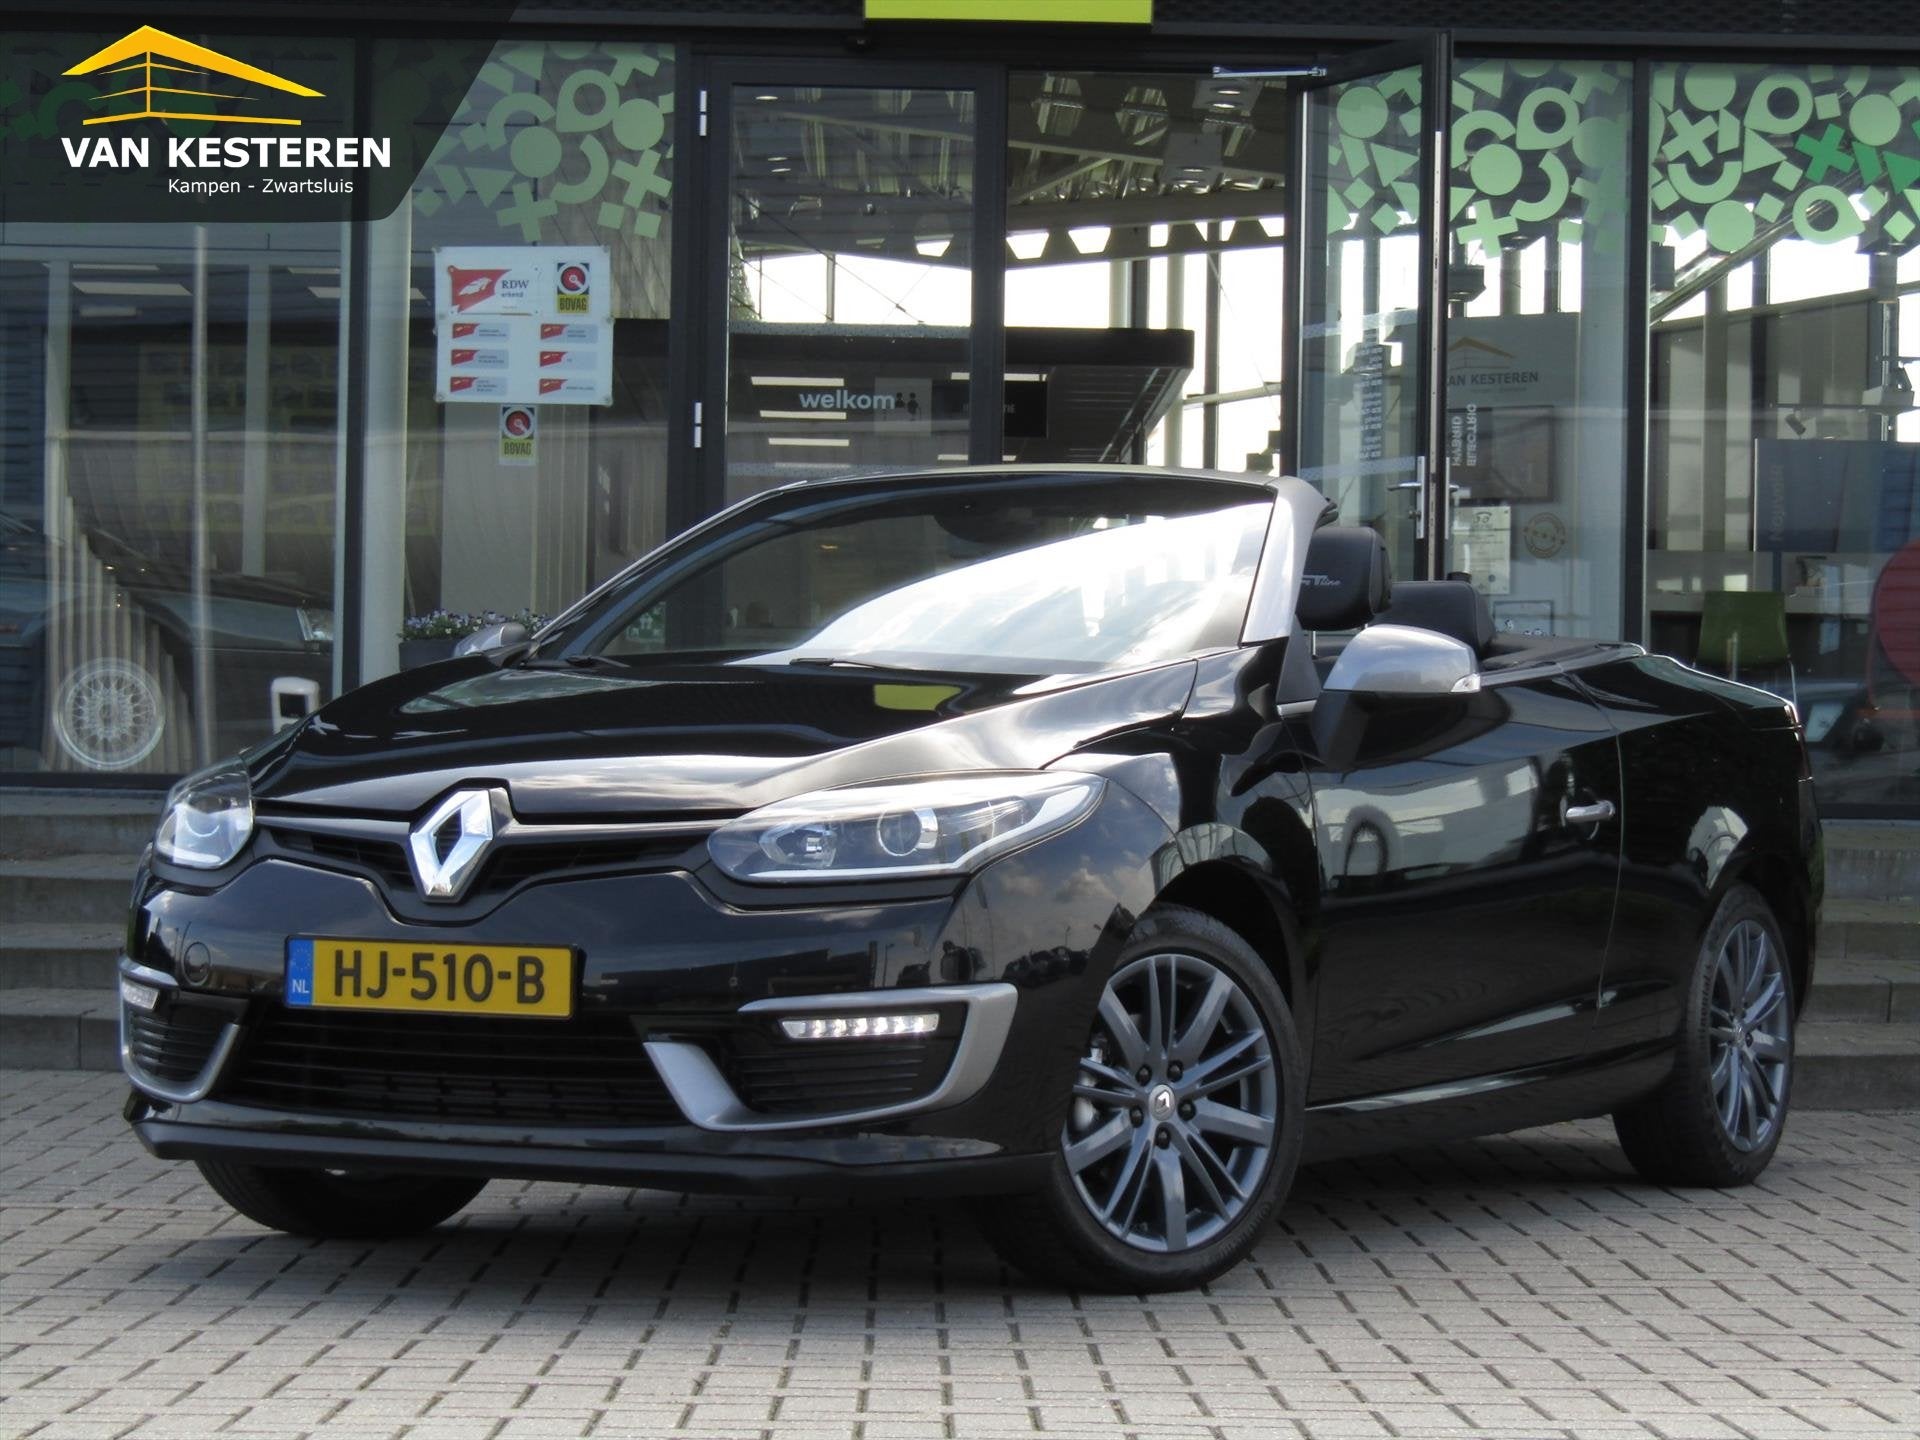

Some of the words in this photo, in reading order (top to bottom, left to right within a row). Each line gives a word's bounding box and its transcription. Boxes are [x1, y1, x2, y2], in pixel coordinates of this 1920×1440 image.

[502, 279, 529, 290] RDW
[559, 297, 587, 311] BOVAG
[1470, 371, 1539, 386] KESTEREN
[800, 390, 896, 410] welkom
[503, 441, 532, 455] BOVAG
[333, 949, 545, 1005] HJ-510-B
[291, 978, 310, 994] NL
